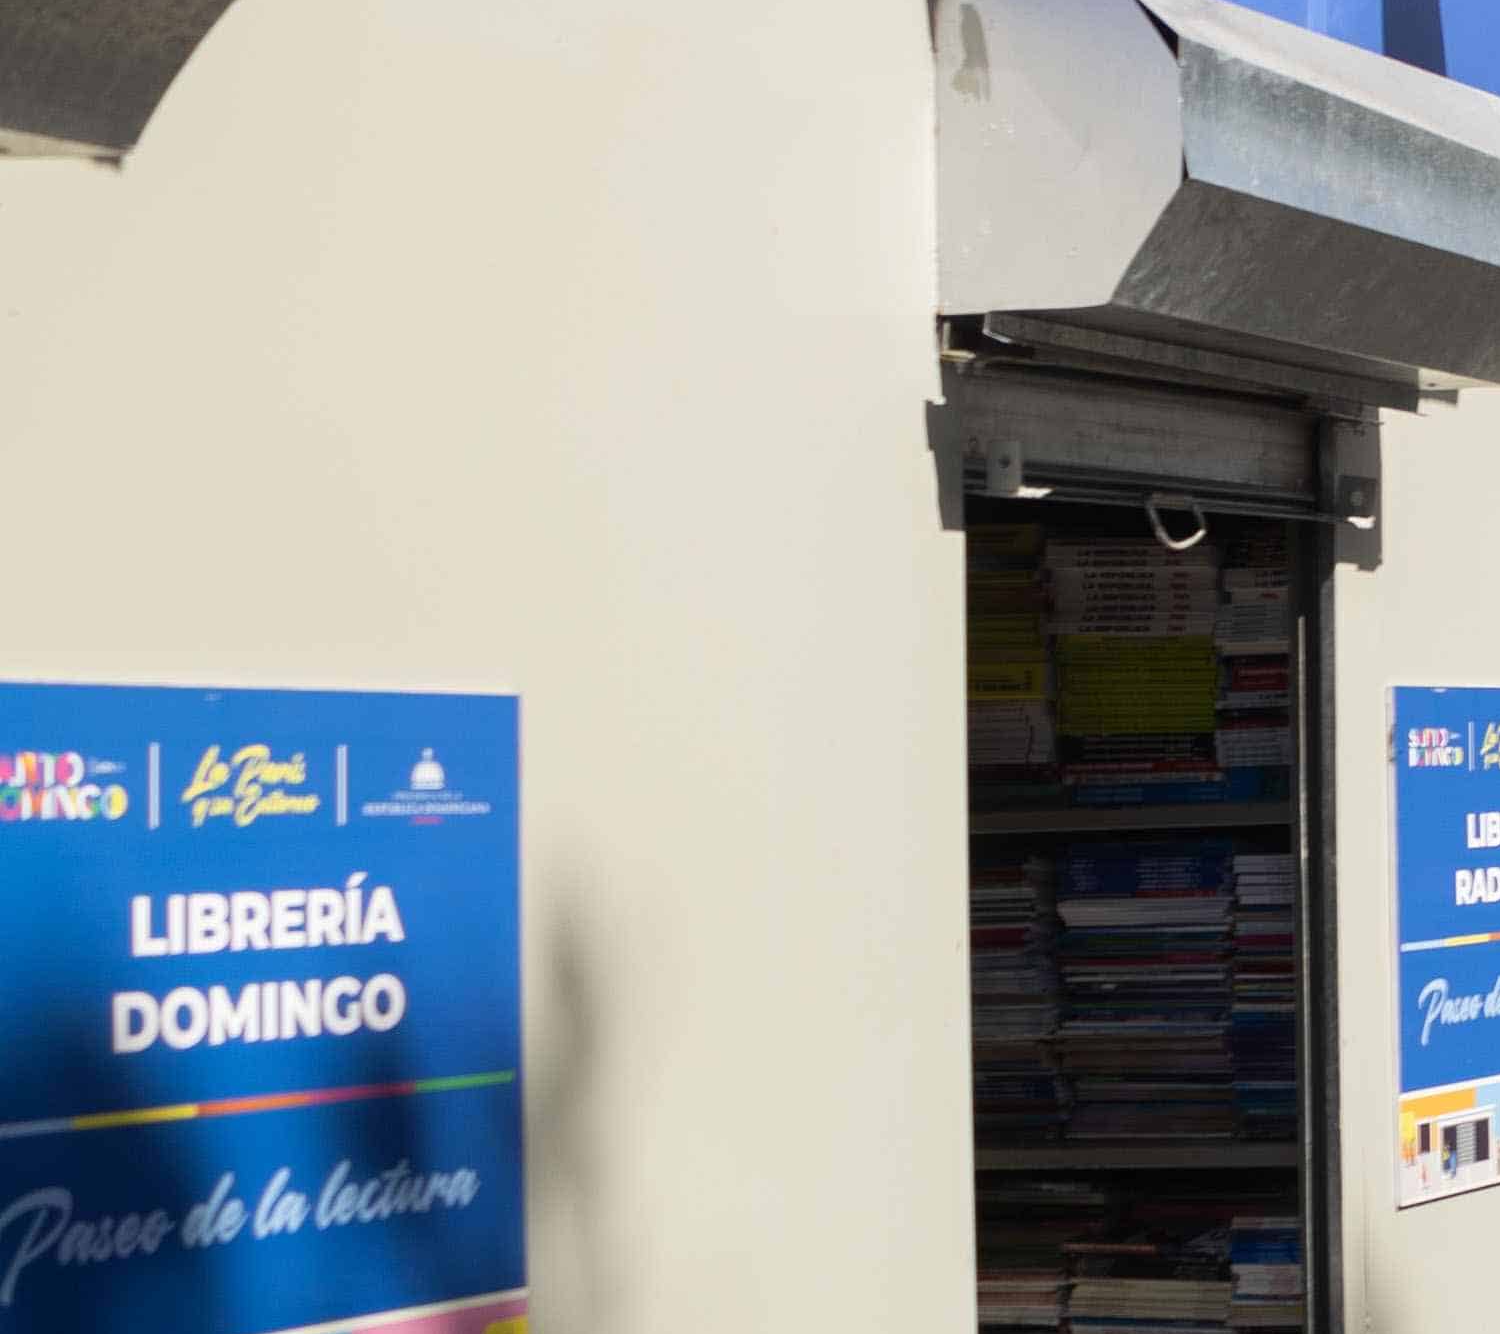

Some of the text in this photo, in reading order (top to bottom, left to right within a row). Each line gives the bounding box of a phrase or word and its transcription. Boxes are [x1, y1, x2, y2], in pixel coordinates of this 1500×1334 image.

[130, 872, 405, 958] LIBRERÍA
[111, 974, 407, 1055] DOMINGO
[1417, 977, 1485, 1047] Paseo
[0, 1159, 481, 1307] Paseo de la lectura
